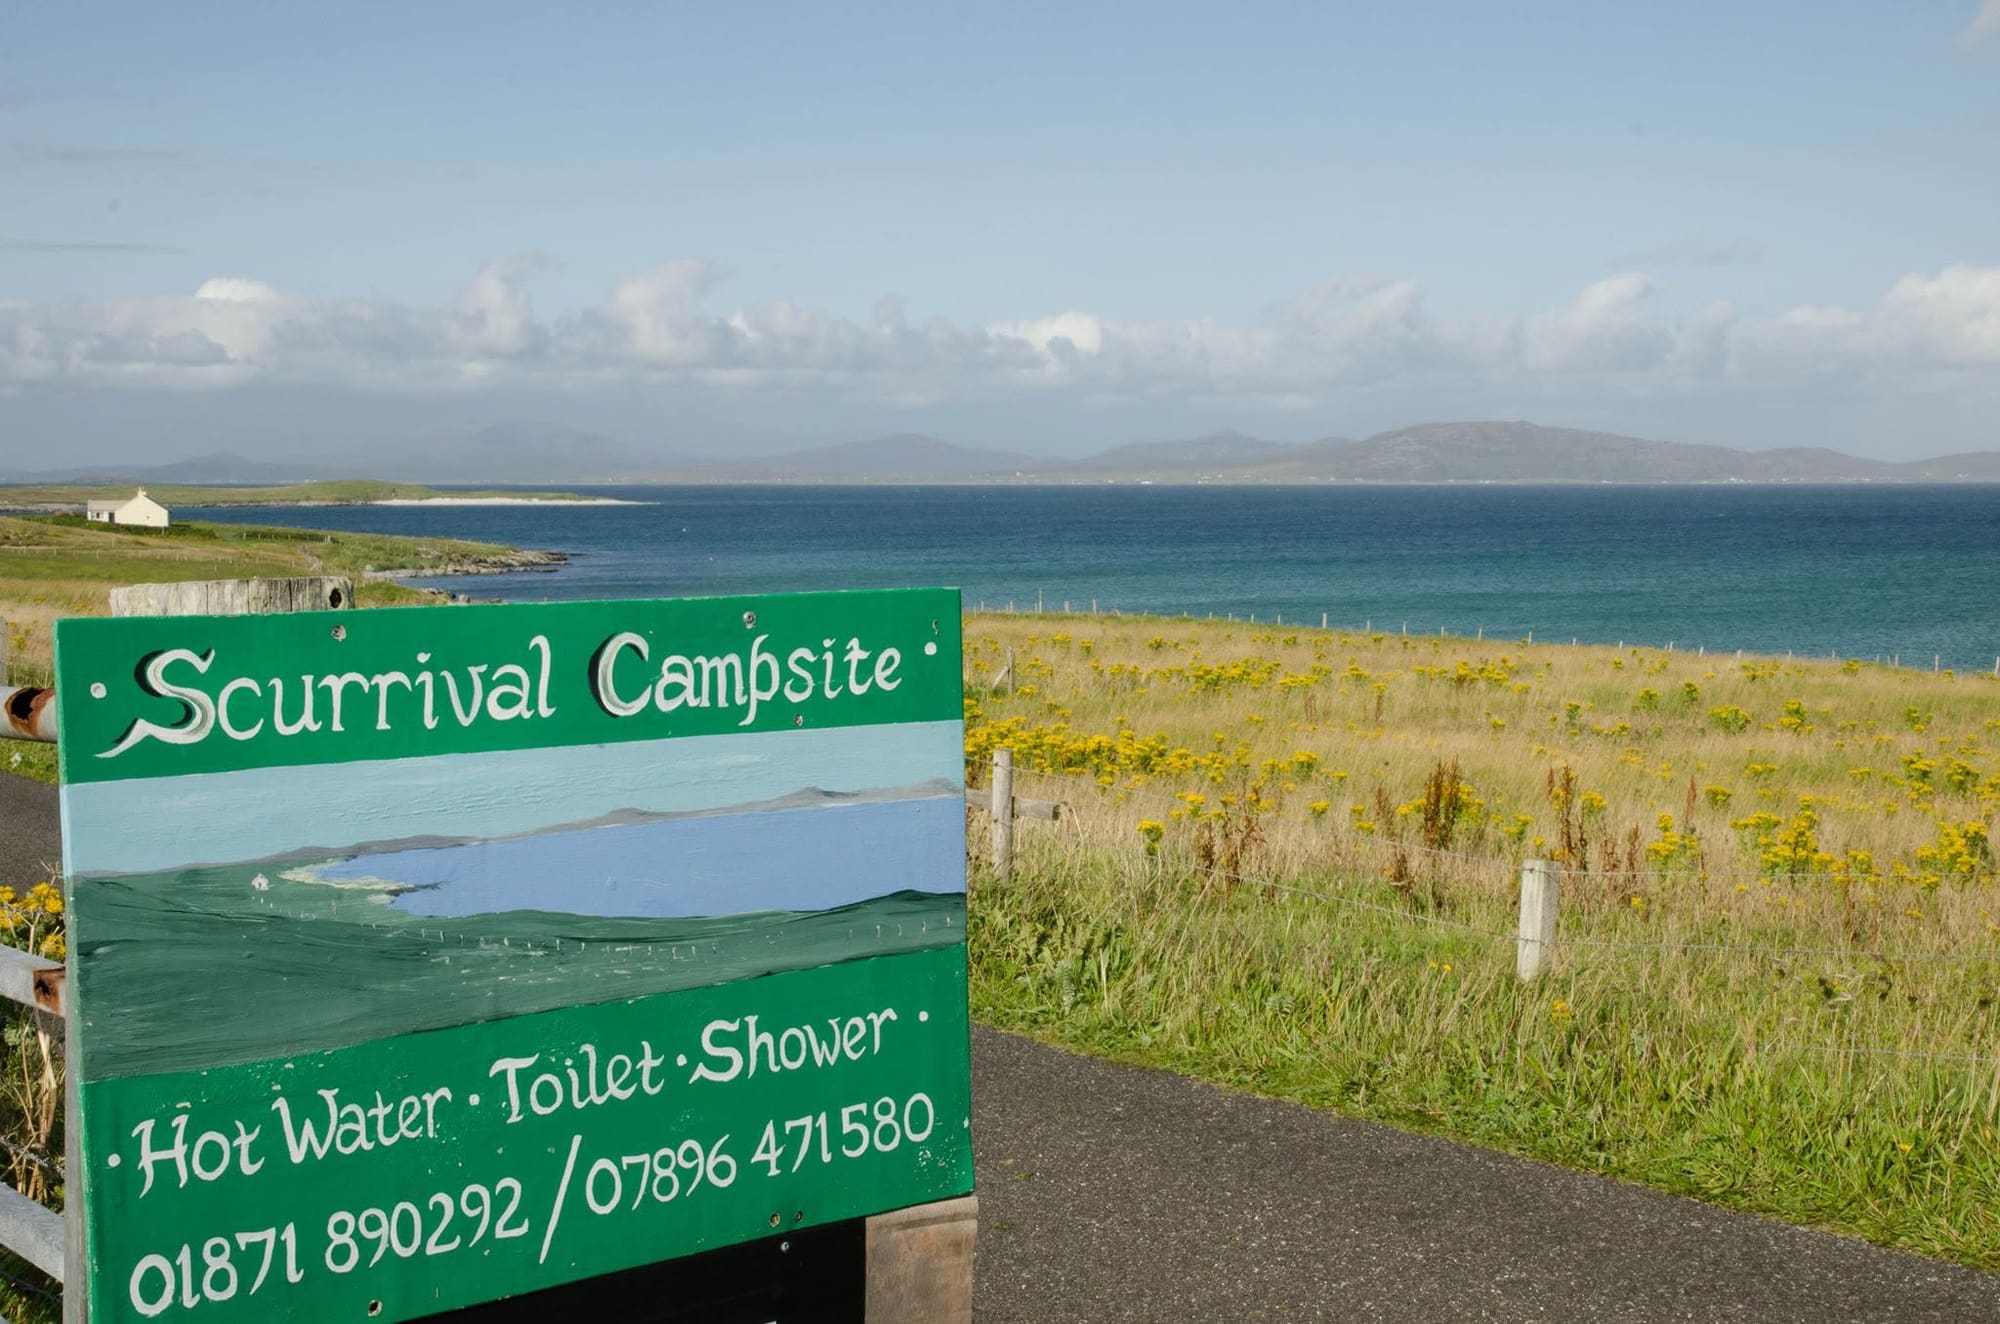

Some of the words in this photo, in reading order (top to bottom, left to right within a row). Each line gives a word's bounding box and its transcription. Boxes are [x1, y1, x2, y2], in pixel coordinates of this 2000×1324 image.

[94, 634, 556, 759] Scurrival
[588, 630, 902, 727] Campsite
[131, 1114, 265, 1199] Hot
[271, 1086, 452, 1163] Water
[489, 1041, 665, 1124] Toilet
[688, 1007, 898, 1084] Shower
[129, 1222, 304, 1318] 01871
[325, 1177, 529, 1269] 890292
[750, 1092, 935, 1177] 471580
